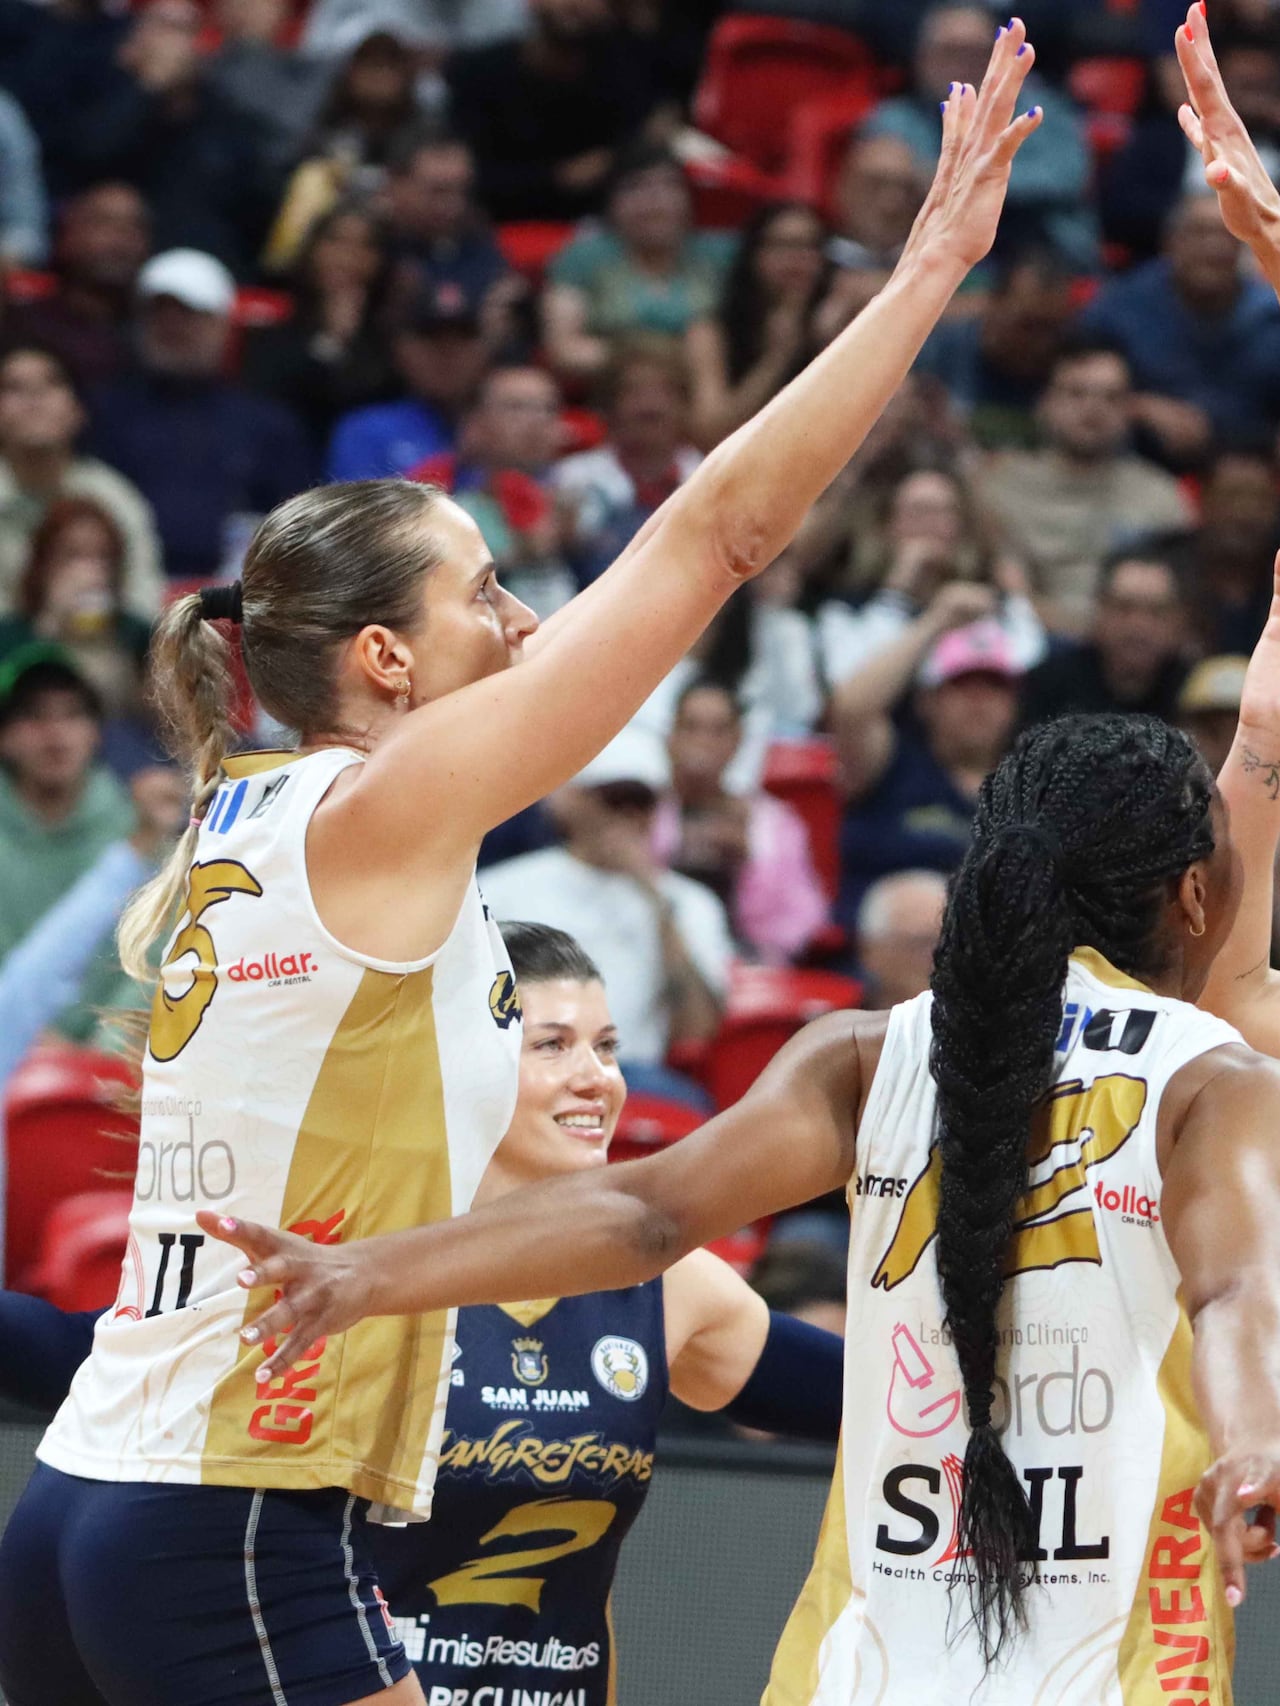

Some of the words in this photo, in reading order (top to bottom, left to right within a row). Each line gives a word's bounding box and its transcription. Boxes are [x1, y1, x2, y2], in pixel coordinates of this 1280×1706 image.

[228, 952, 318, 982] dollar.
[481, 1386, 528, 1405] SAN
[531, 1389, 590, 1407] JUAN
[426, 1495, 617, 1614] 2
[873, 1562, 925, 1581] Health
[1088, 1570, 1111, 1583] Inc.
